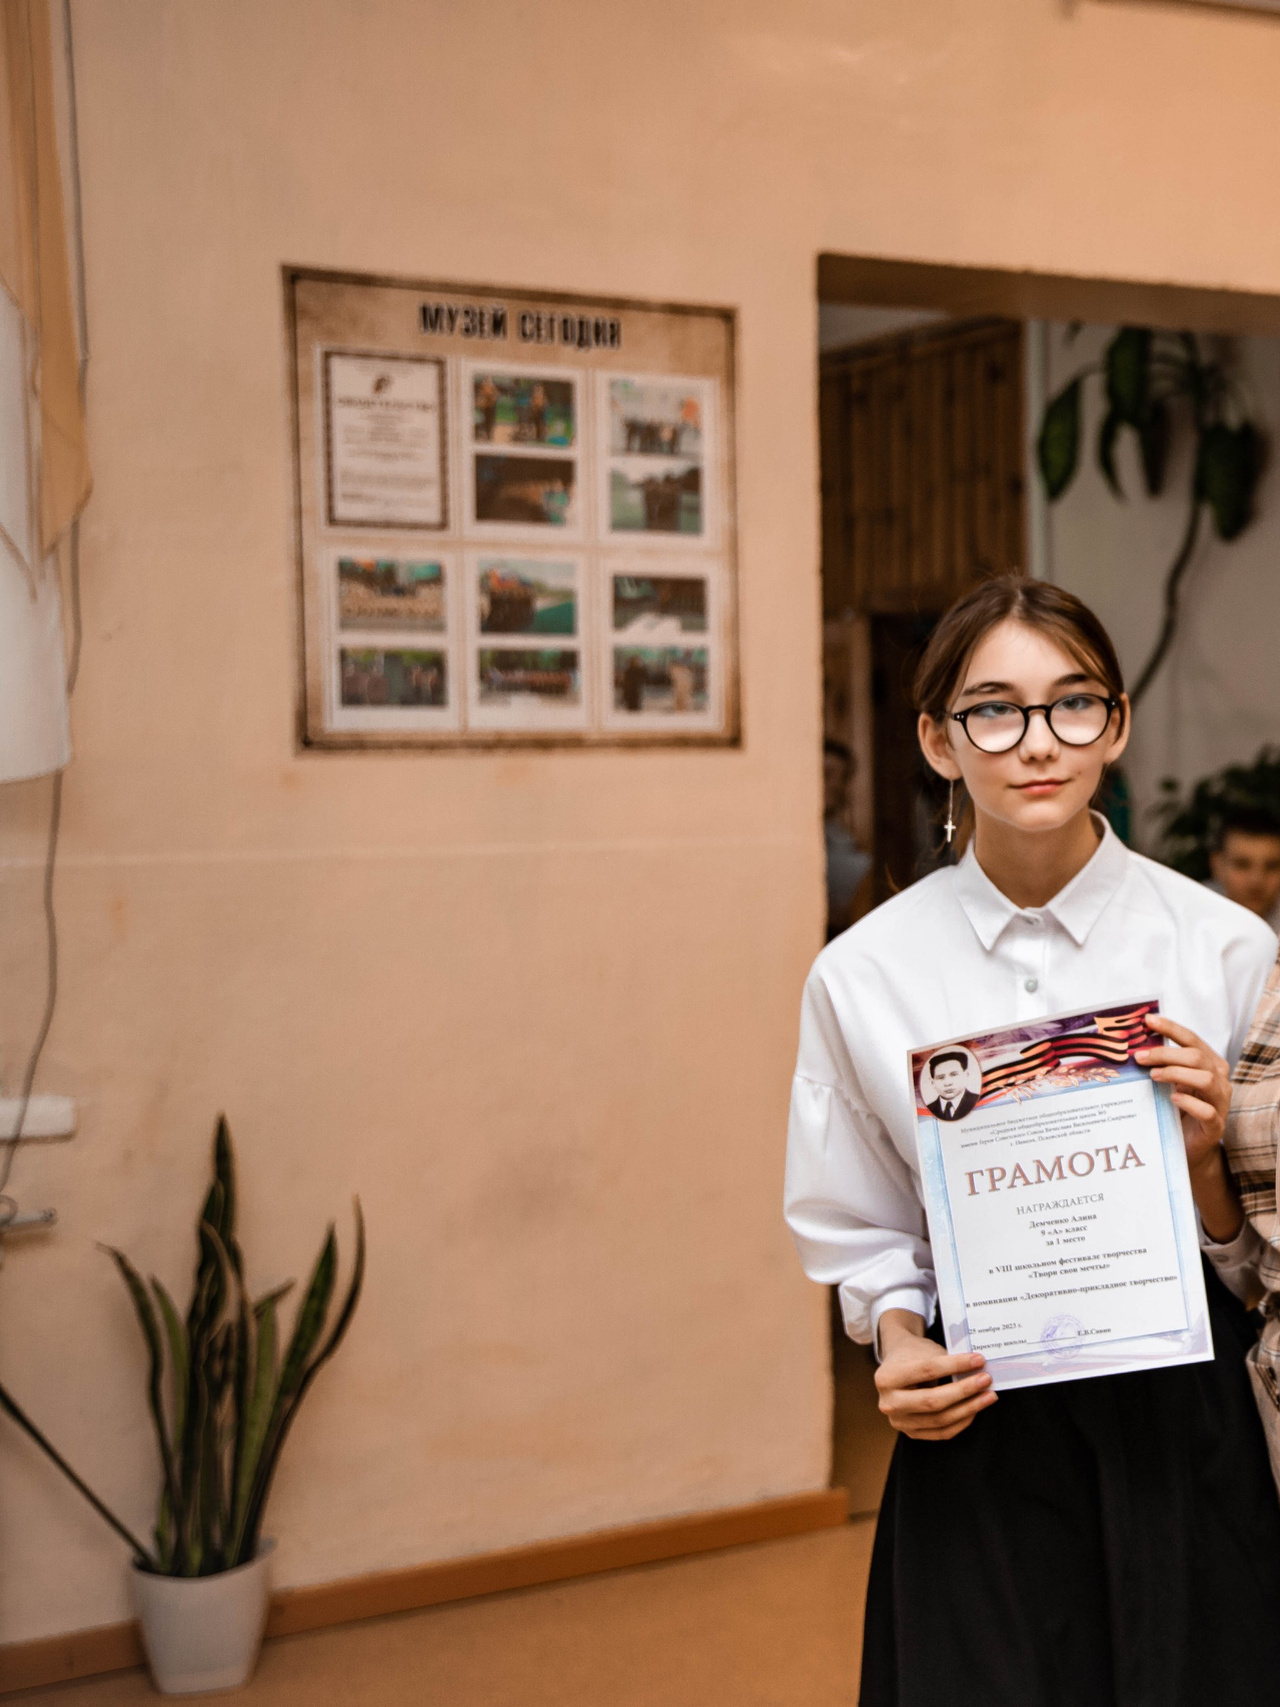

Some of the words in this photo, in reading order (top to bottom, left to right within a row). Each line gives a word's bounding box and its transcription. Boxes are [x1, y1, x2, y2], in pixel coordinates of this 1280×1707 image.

[419, 302, 509, 340] МУЗЕЙ
[517, 310, 622, 351] СЕГОДНЯ
[965, 1143, 1146, 1197] ГРАМОТА
[1016, 1192, 1105, 1216] НАГРАЖДАЕТСЯ
[1029, 1217, 1069, 1230] Демченко
[1070, 1213, 1098, 1222] Алина
[1047, 1227, 1063, 1236] «А»
[1064, 1225, 1088, 1233] класс
[1056, 1237, 1060, 1245] 1
[1062, 1235, 1086, 1244] место
[995, 1264, 1013, 1273] VIII
[1014, 1260, 1057, 1271] школьном
[1058, 1254, 1101, 1266] фестивале
[1103, 1248, 1147, 1259] творчества
[1028, 1270, 1058, 1279] «Твори
[1059, 1267, 1078, 1275] свои
[1080, 1263, 1110, 1272] мечты»
[972, 1296, 1019, 1307] номинации
[1020, 1281, 1128, 1301] «Декоративно-прикладное
[1129, 1275, 1178, 1286] творчество»
[971, 1342, 1002, 1351] Директор
